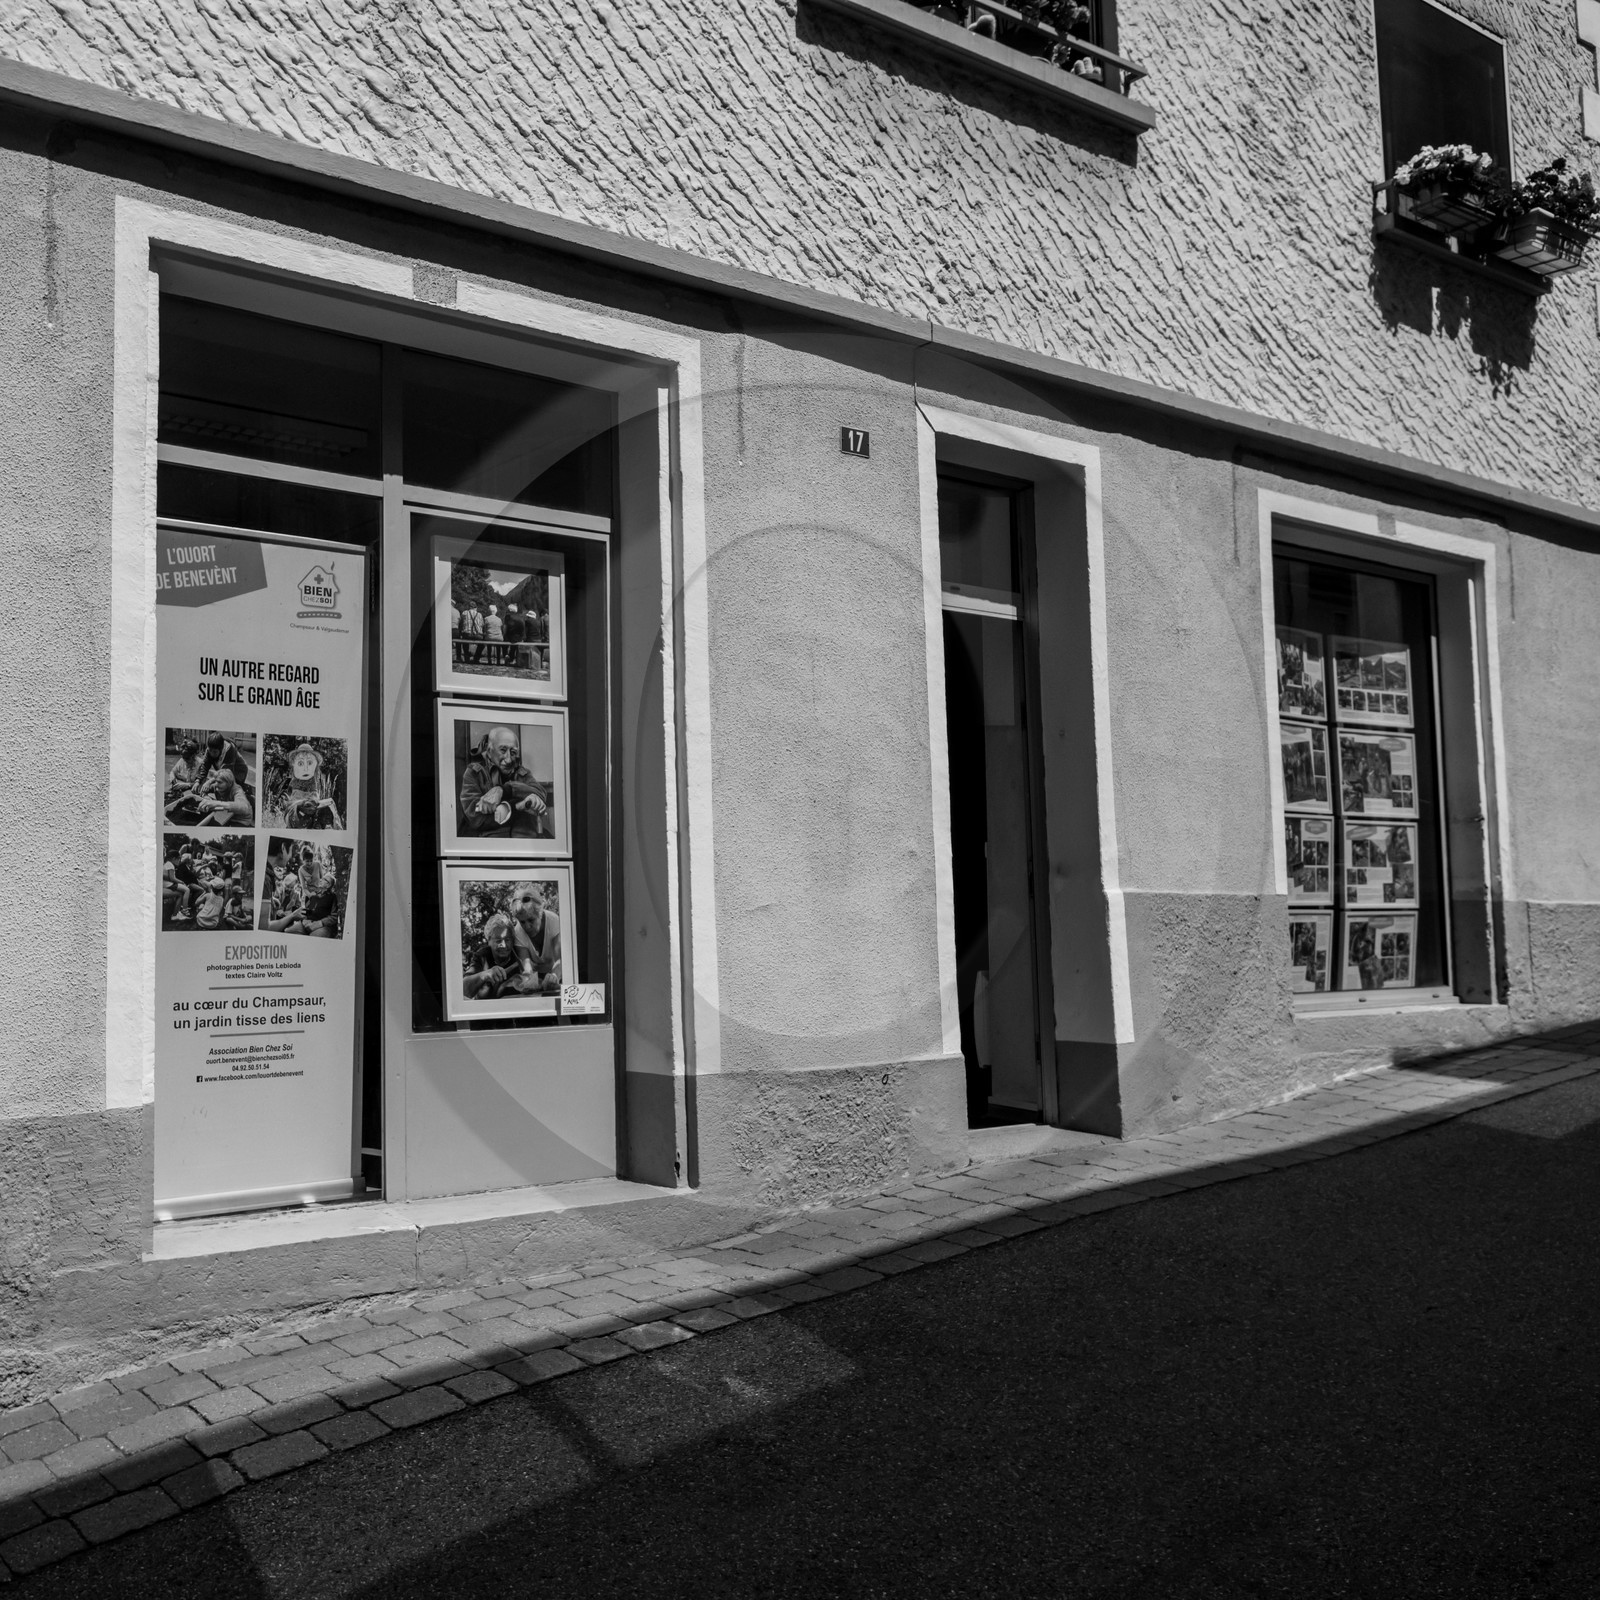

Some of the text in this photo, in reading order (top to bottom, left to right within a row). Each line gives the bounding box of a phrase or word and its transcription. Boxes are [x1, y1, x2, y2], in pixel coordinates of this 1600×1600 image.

[848, 430, 864, 453] 17
[166, 544, 216, 565] L'OUORT
[156, 565, 237, 590] DE BENEVÈNT
[303, 585, 332, 597] BIEN
[200, 657, 320, 684] UN AUTRE REGARD
[198, 682, 320, 709] SUR LE GRAND ÂGE
[225, 944, 288, 960] EXPOSITION
[206, 962, 254, 972] photographies
[256, 962, 274, 970] Denis
[247, 971, 266, 979] Claire
[173, 996, 327, 1011] au cœur du Champsaur,
[173, 1012, 326, 1031] un jardin tisse des liens
[209, 1043, 294, 1056] Association Bien Chez Soi
[206, 1053, 295, 1065] ouort.benevent@bienchezsoi05.fr
